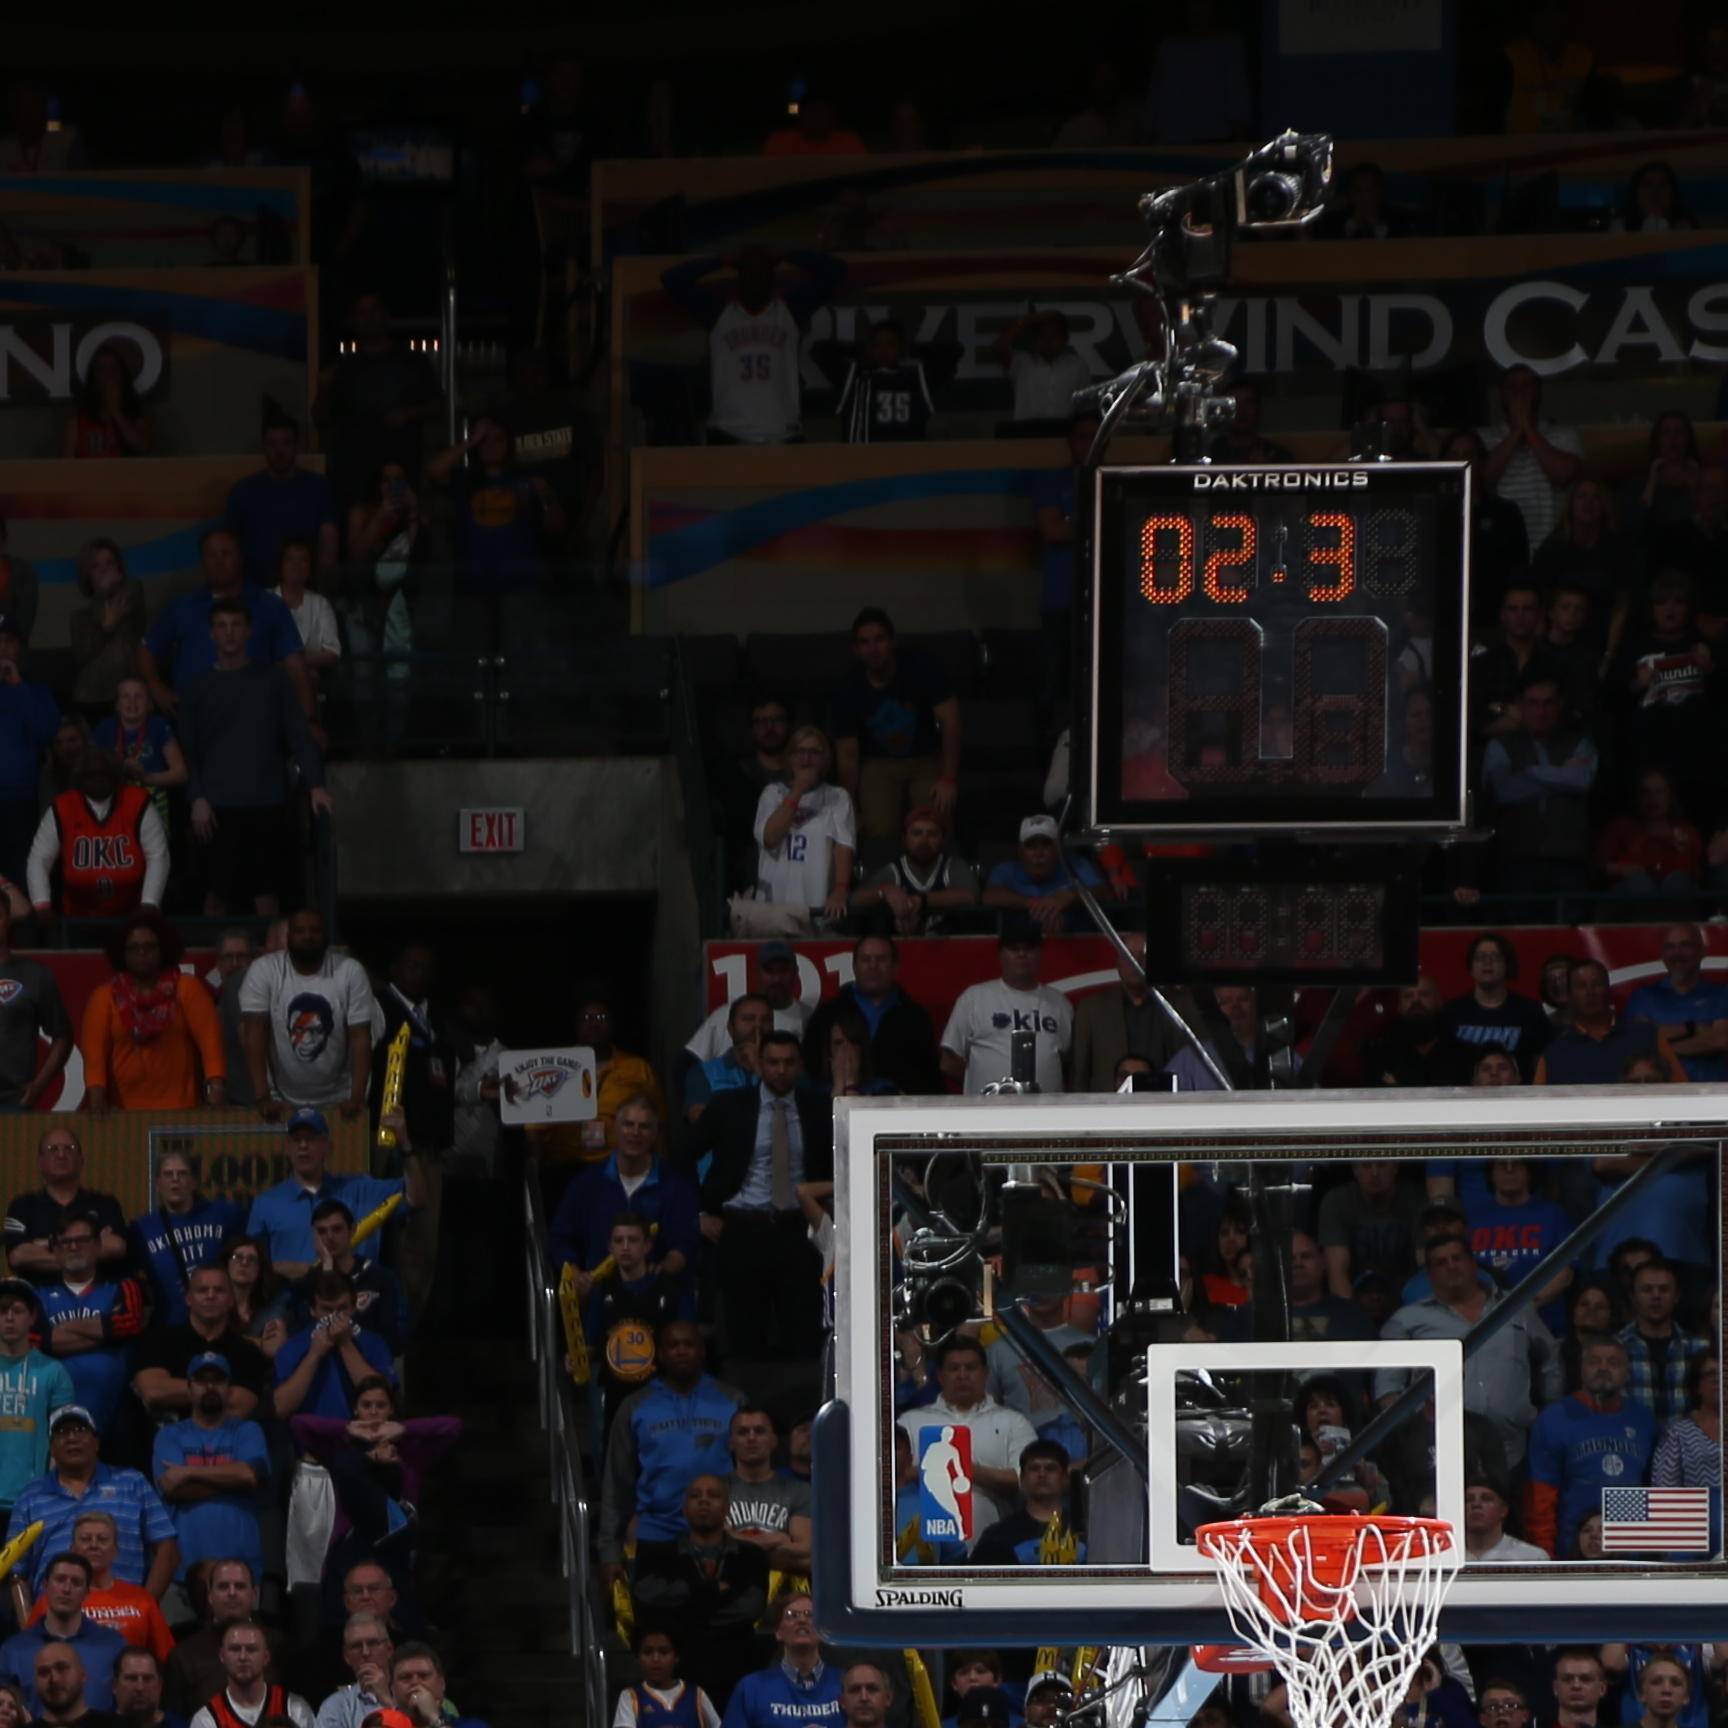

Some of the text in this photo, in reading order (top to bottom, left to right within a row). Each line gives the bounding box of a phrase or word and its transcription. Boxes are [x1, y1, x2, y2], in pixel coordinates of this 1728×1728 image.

[875, 390, 913, 425] 35
[1192, 470, 1370, 492] DAKTRONICS
[469, 811, 515, 850] EXIT
[72, 837, 135, 872] OKC
[1472, 1225, 1544, 1252] OKC
[925, 1518, 956, 1537] NBA
[875, 1589, 964, 1608] SPALDING
[770, 1700, 841, 1718] THUNDER
